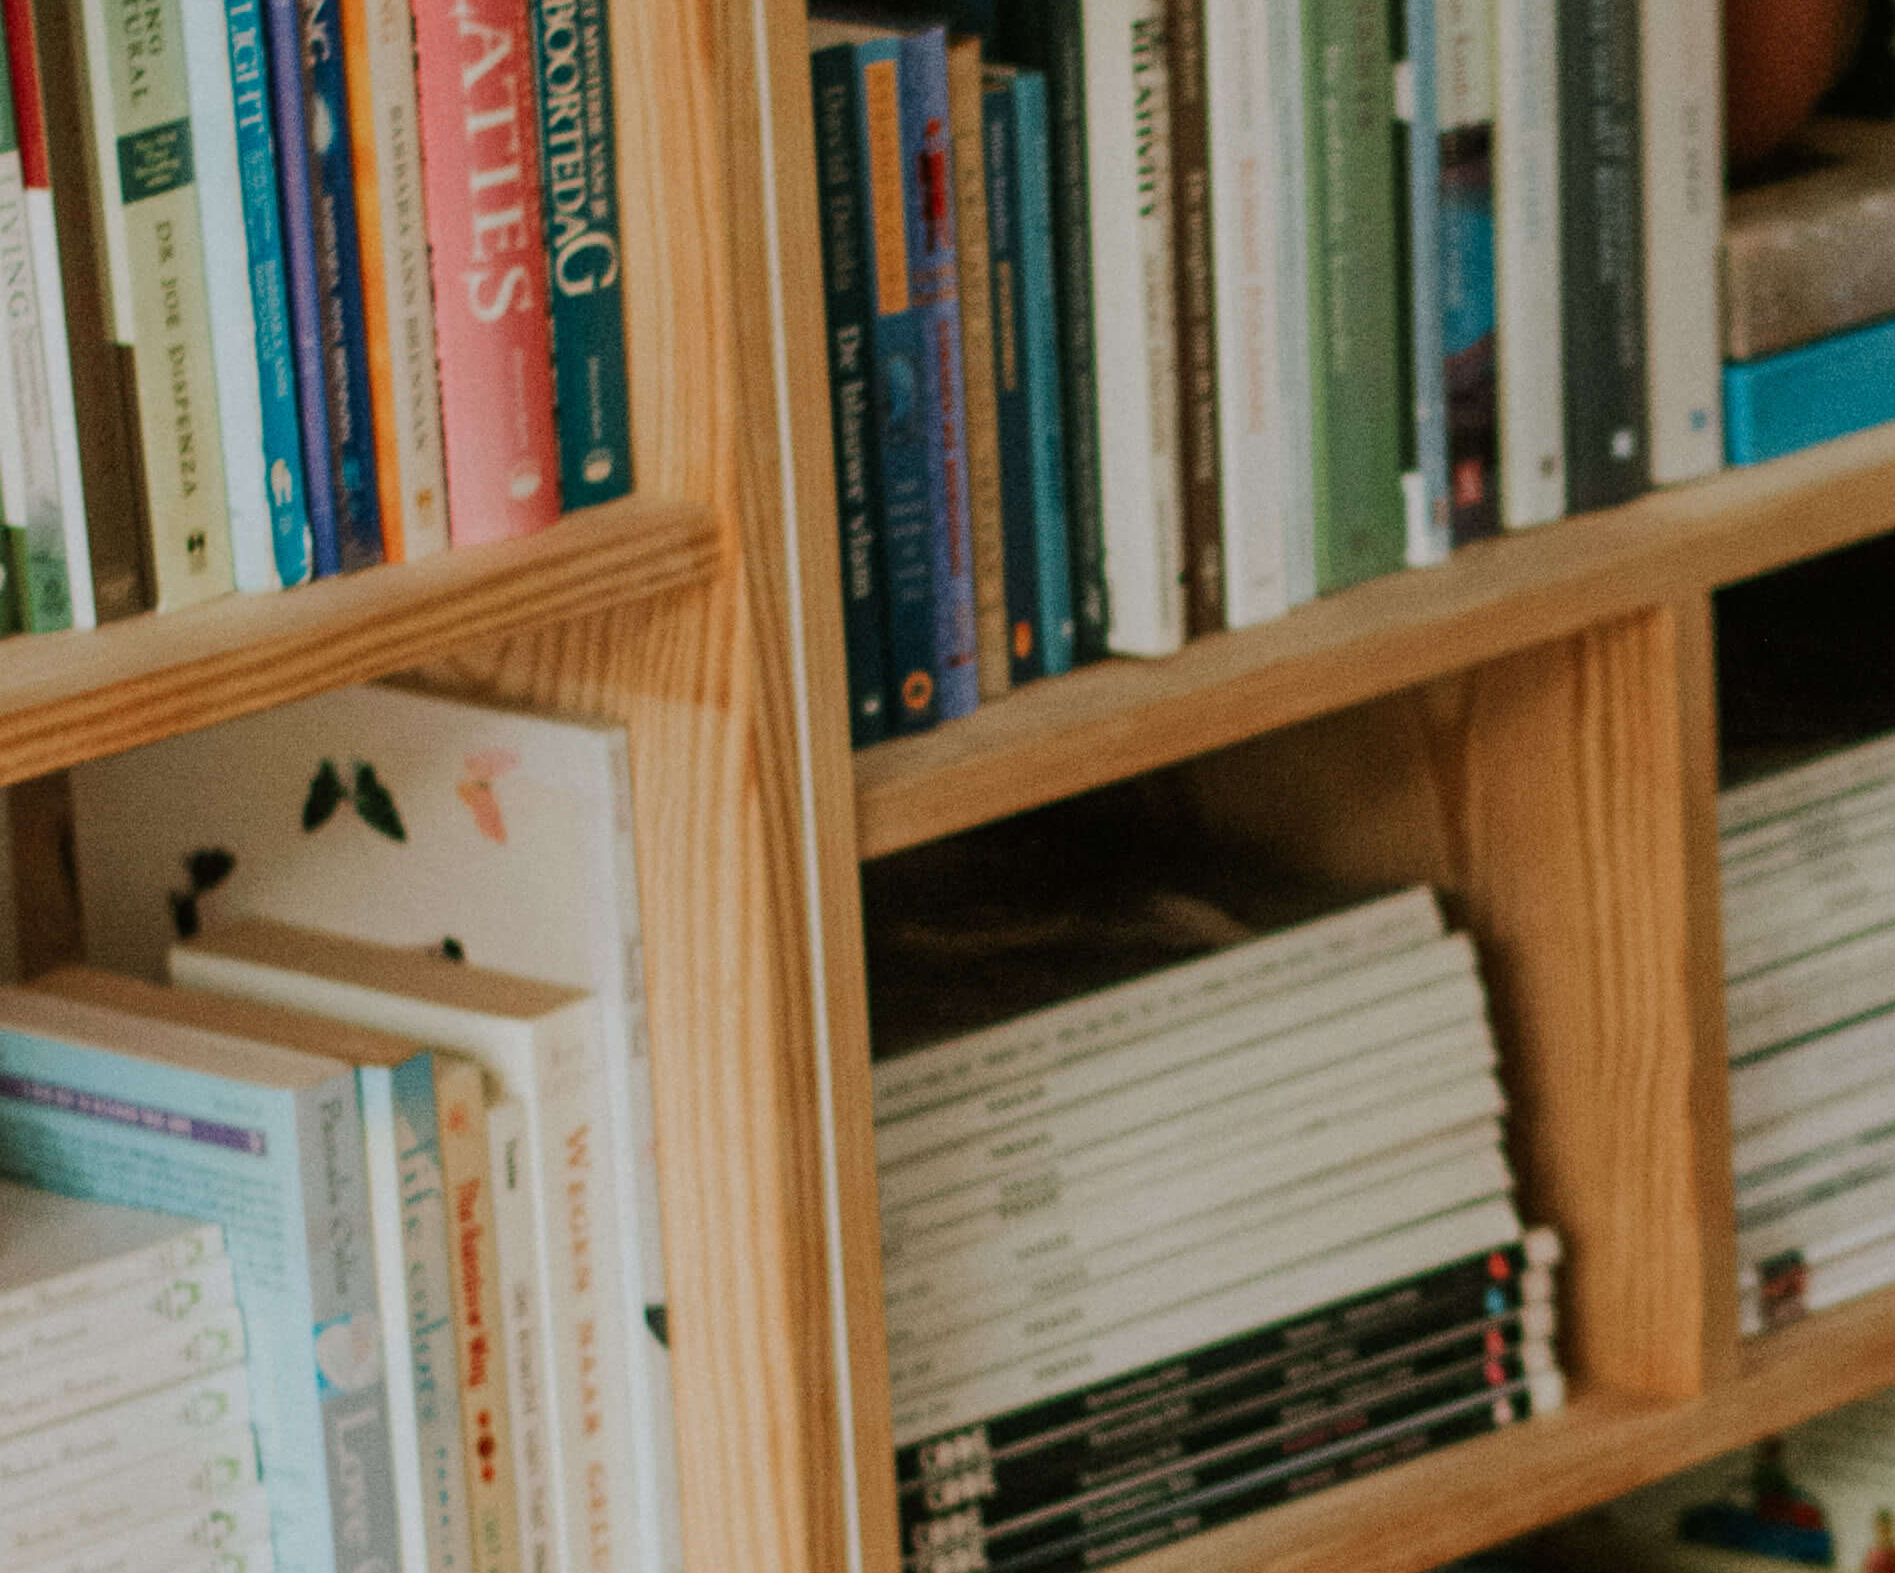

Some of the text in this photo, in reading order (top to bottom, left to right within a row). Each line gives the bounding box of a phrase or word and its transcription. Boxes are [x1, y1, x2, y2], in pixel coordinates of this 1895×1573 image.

[228, 1, 268, 137] LIGHT
[158, 274, 181, 332] JOE
[333, 1408, 389, 1542] Love
